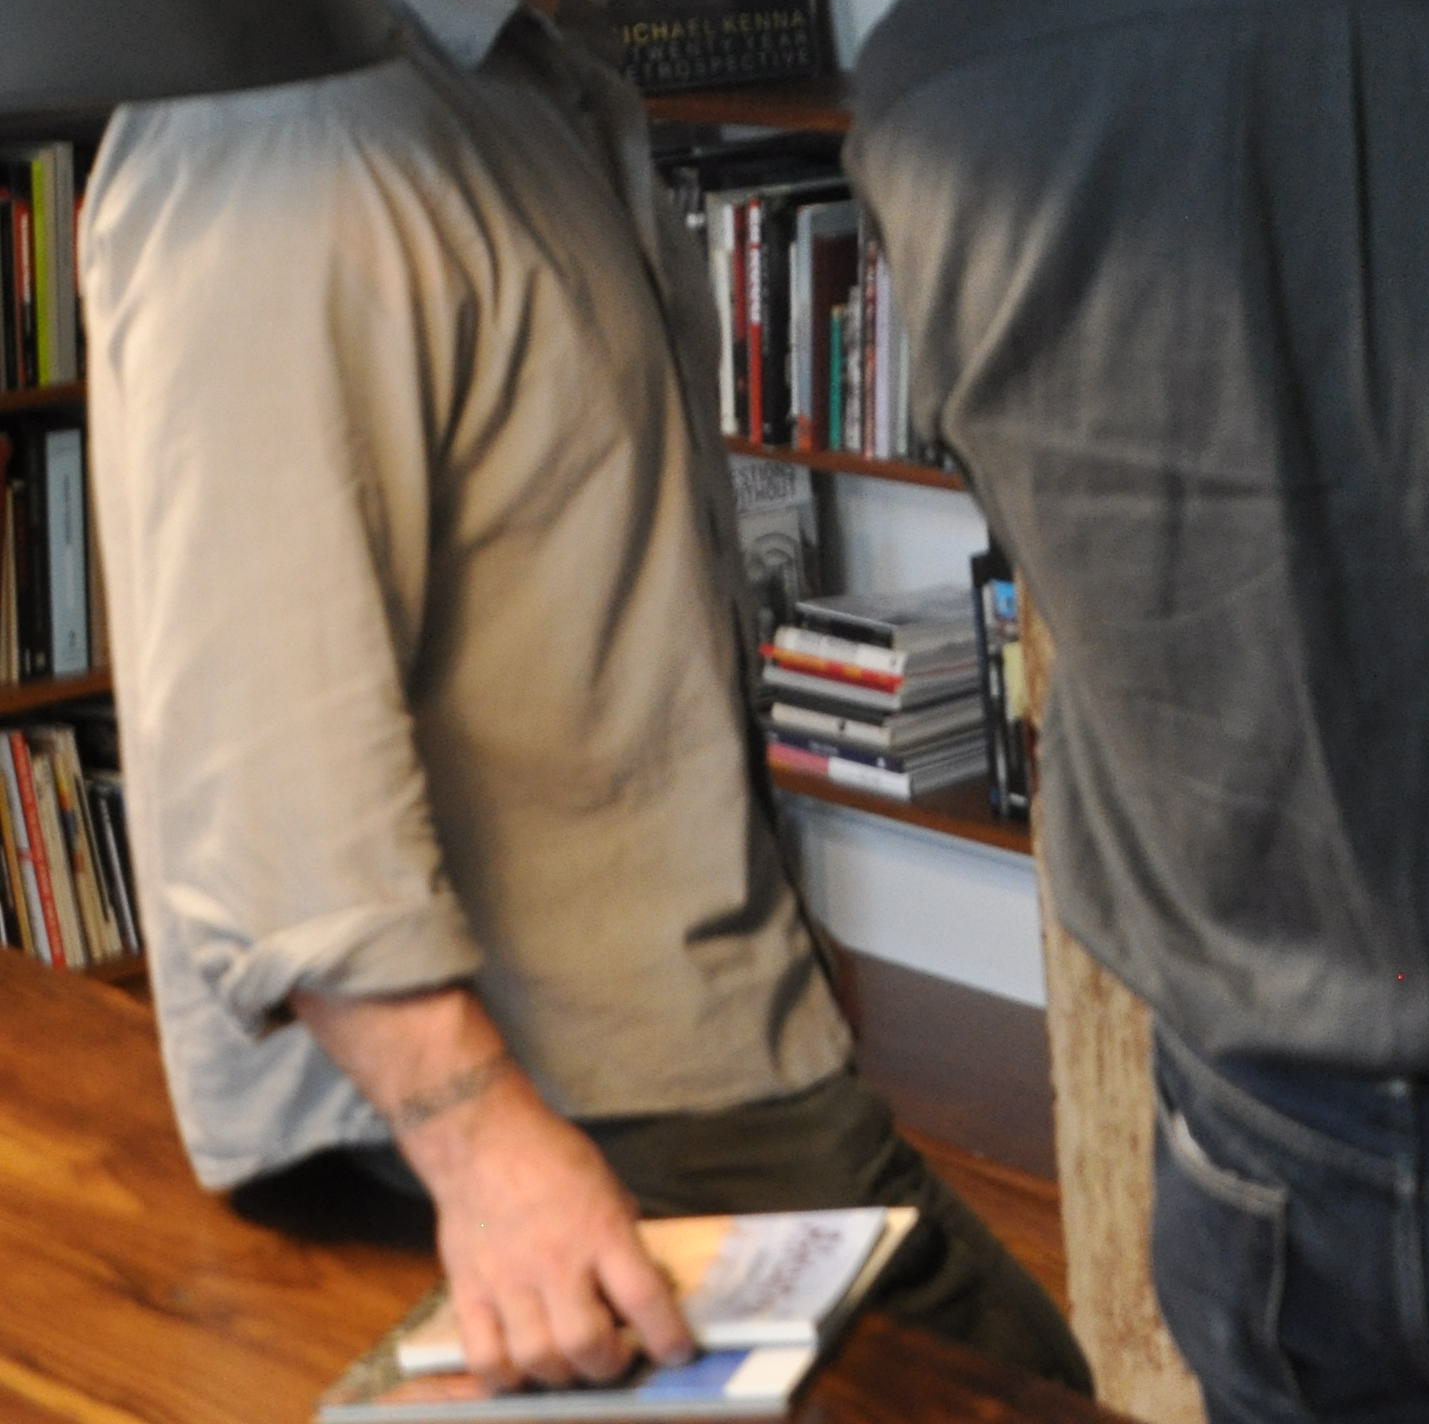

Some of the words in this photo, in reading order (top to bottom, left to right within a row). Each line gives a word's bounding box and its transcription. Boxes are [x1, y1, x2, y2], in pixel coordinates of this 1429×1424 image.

[610, 17, 716, 45] ICHAEL
[721, 10, 807, 35] KENNA
[625, 50, 816, 82] ETROSPECTIVE
